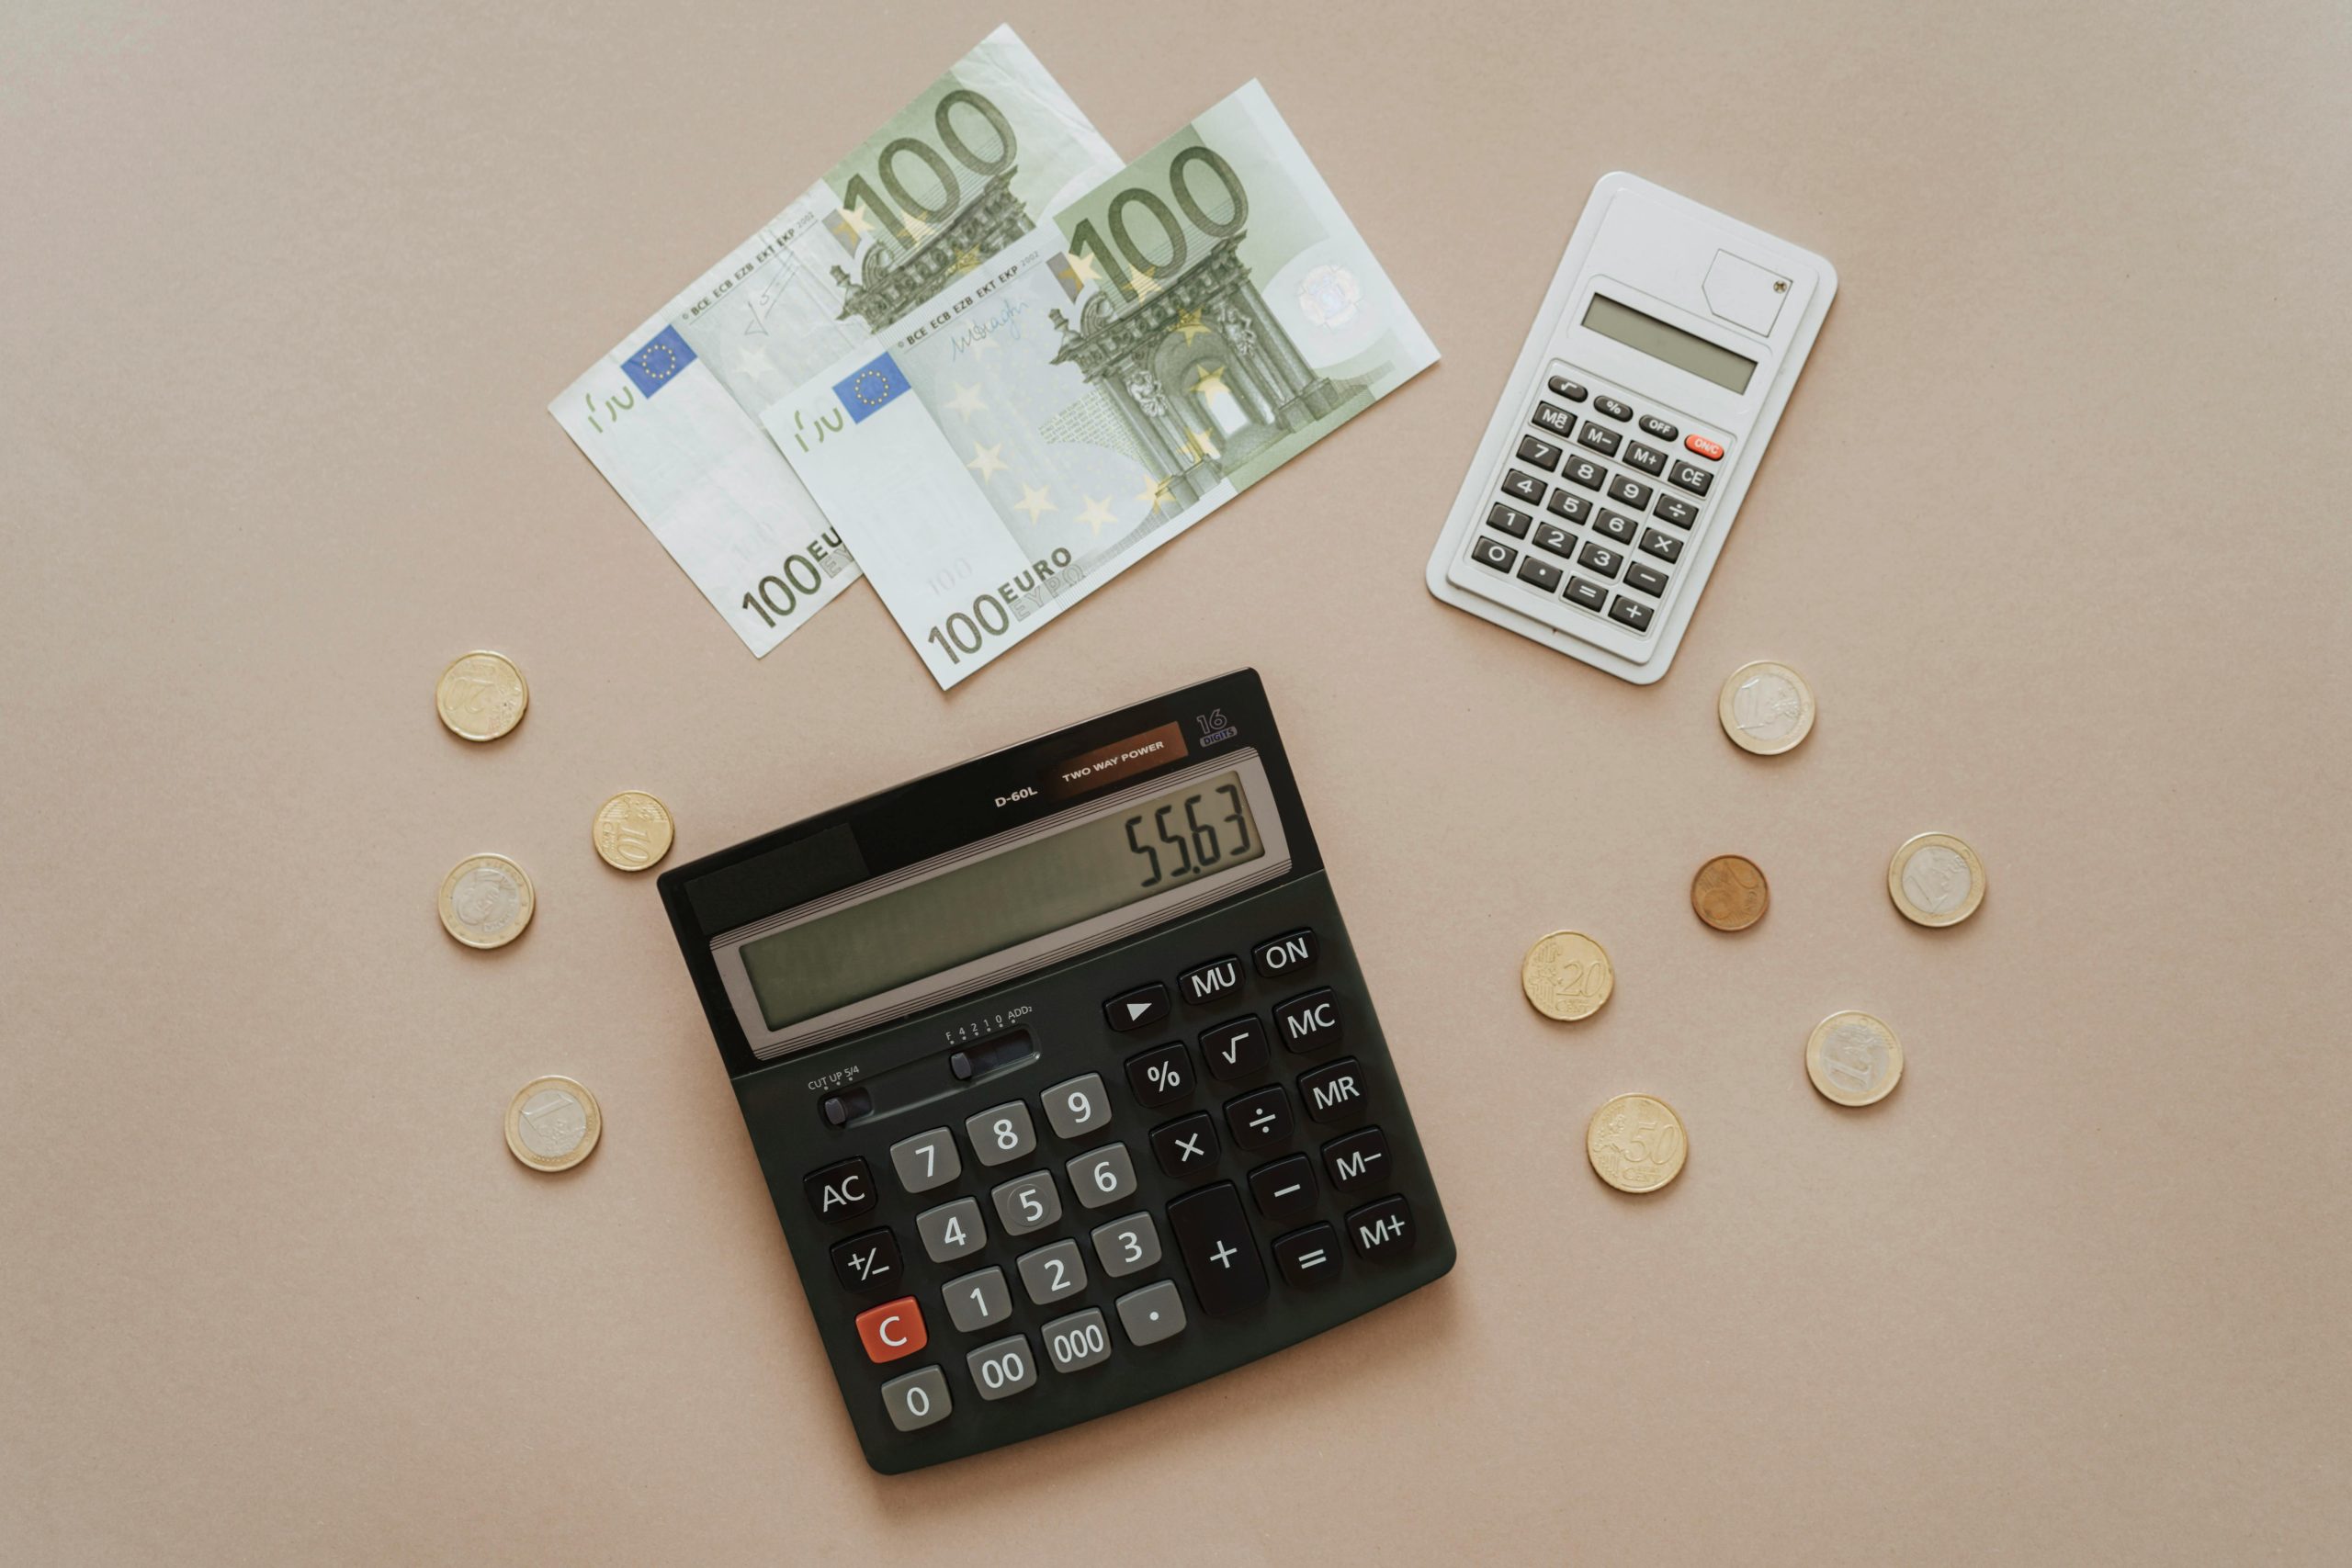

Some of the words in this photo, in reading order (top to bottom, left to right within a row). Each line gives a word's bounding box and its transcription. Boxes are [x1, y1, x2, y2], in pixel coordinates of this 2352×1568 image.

[842, 89, 1017, 251] 100
[1069, 146, 1249, 304] 100
[690, 297, 711, 316] BCE
[713, 279, 733, 299] ECB
[734, 263, 754, 280] EZB
[755, 245, 775, 263] EKT
[775, 228, 796, 246] EKP
[796, 211, 815, 229] 2002
[906, 326, 928, 345] BCE
[930, 310, 952, 330] ECB
[953, 296, 974, 314] EZB
[976, 279, 997, 299] EKT
[998, 265, 1019, 284] EKP
[1020, 250, 1040, 266] 2002
[1649, 420, 1671, 434] OFF
[1535, 445, 1549, 458] 7
[1634, 448, 1657, 465] M+
[1517, 479, 1533, 494] 4
[1577, 464, 1594, 479] 8
[1681, 468, 1705, 487] CE
[1563, 499, 1579, 513] 5
[1623, 483, 1640, 499] 9
[1506, 513, 1516, 526] 1
[1609, 518, 1624, 533] 6
[1548, 530, 1566, 548] 2
[1594, 550, 1611, 567] 3
[741, 554, 822, 629] 100
[927, 593, 1010, 664] 100
[997, 547, 1072, 604] EURO
[1196, 708, 1227, 734] 16
[1204, 728, 1235, 745] DIGITS
[1062, 766, 1091, 784] TWO
[1092, 757, 1119, 773] WAY
[1120, 740, 1165, 763] POWER
[994, 785, 1038, 809] D-60L
[1266, 937, 1309, 970] ON
[1192, 963, 1237, 998] MU
[1555, 960, 1606, 998] 20
[945, 1032, 953, 1041] F
[958, 1027, 966, 1036] 4
[971, 1023, 978, 1032] 2
[983, 1019, 990, 1028] 1
[995, 1014, 1002, 1023] 0
[1287, 1002, 1336, 1039] MC
[808, 1077, 829, 1090] CUT
[830, 1071, 843, 1083] UP
[844, 1066, 860, 1077] 5/4
[1313, 1075, 1360, 1110] MR
[1068, 1091, 1091, 1123] 9
[993, 1119, 1019, 1150] 8
[1623, 1121, 1679, 1166] 50
[915, 1145, 935, 1178] 7
[1093, 1161, 1117, 1192] 6
[823, 1175, 865, 1213] AC
[1019, 1189, 1044, 1222] 5
[944, 1216, 967, 1247] 4
[1118, 1231, 1143, 1262] 3
[1360, 1214, 1406, 1249] M+
[1044, 1259, 1071, 1292] 2
[969, 1287, 989, 1316] 1
[878, 1315, 908, 1348] C
[1054, 1325, 1104, 1363] 000
[981, 1353, 1024, 1389] 00
[906, 1387, 930, 1416] 0
